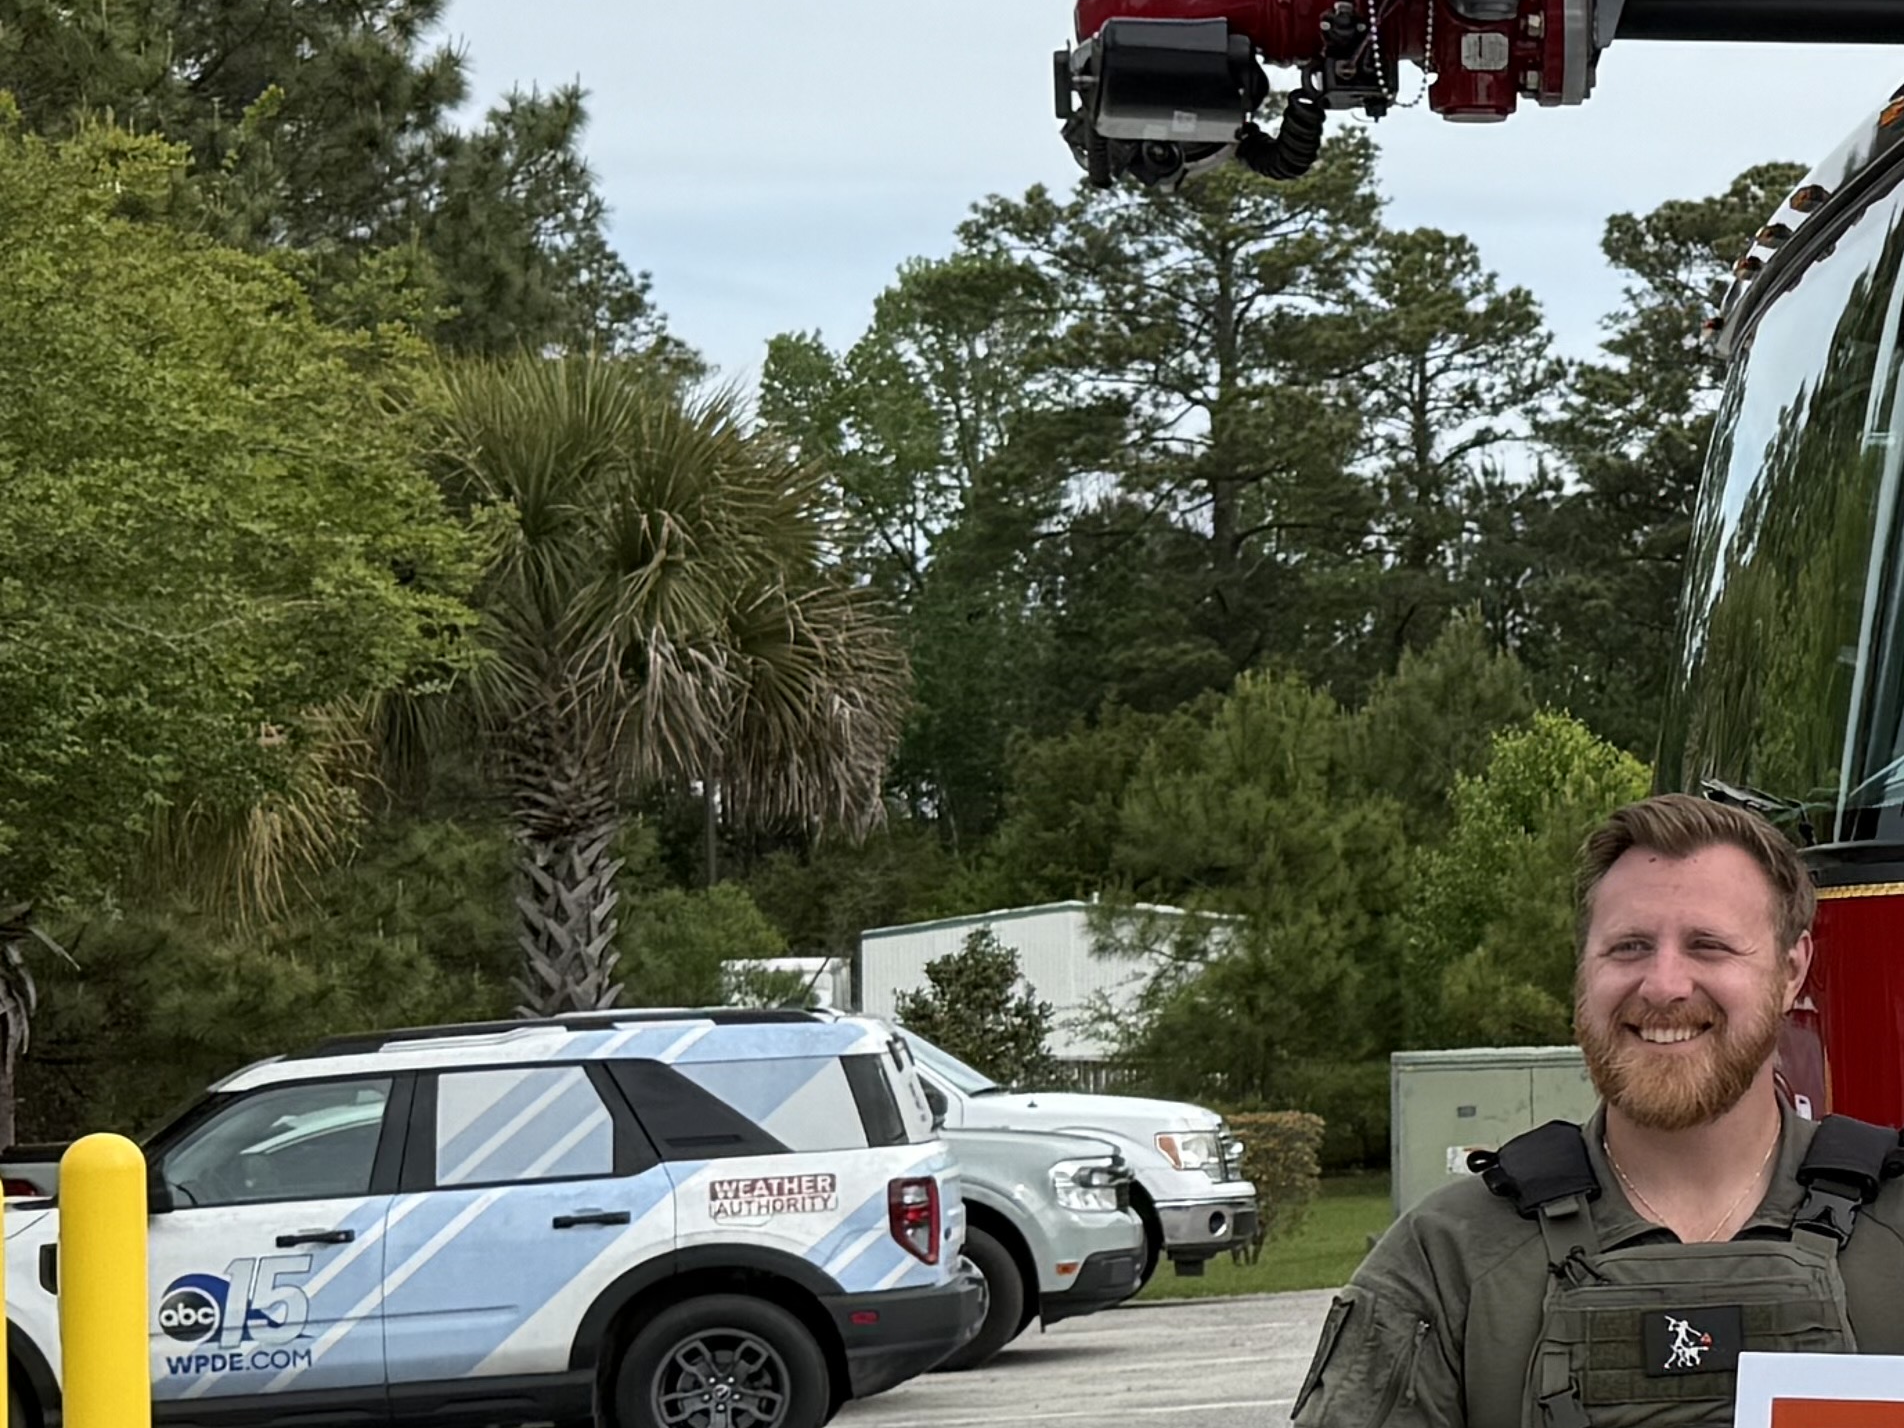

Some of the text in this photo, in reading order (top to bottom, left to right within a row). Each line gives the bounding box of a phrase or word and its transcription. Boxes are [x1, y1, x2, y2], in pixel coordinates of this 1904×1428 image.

[715, 1175, 832, 1199] WEATHER
[716, 1193, 832, 1217] AUTHORITY
[160, 1253, 314, 1350] abc 15
[166, 1348, 312, 1375] WPDE.COM
